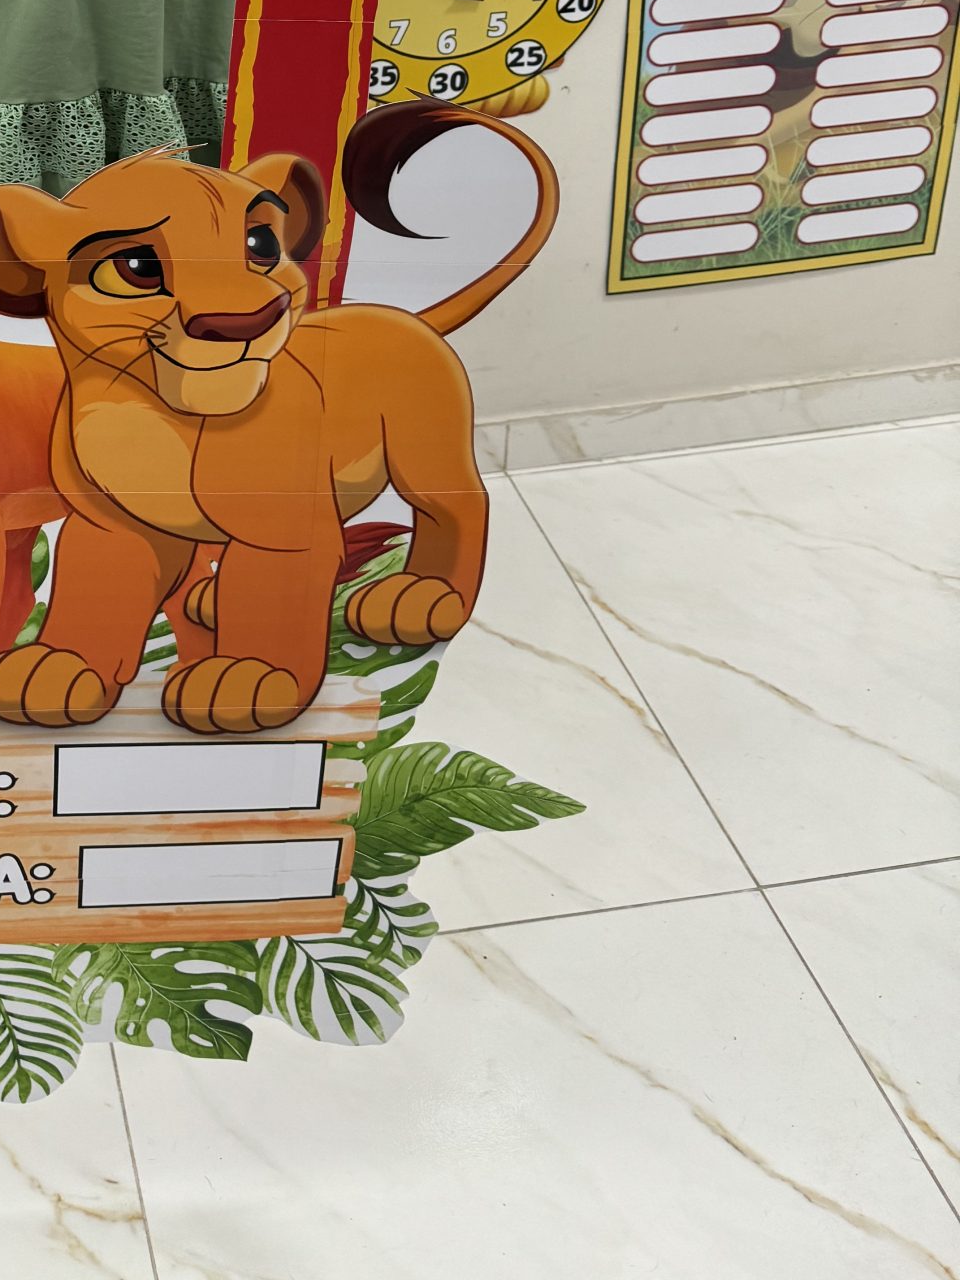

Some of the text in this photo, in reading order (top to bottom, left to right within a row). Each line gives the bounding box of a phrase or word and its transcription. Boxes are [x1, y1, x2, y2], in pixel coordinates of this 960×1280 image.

[389, 19, 410, 45] 7
[487, 11, 507, 37] 5
[437, 29, 457, 55] 6
[508, 46, 543, 67] 25
[432, 71, 465, 94] 30
